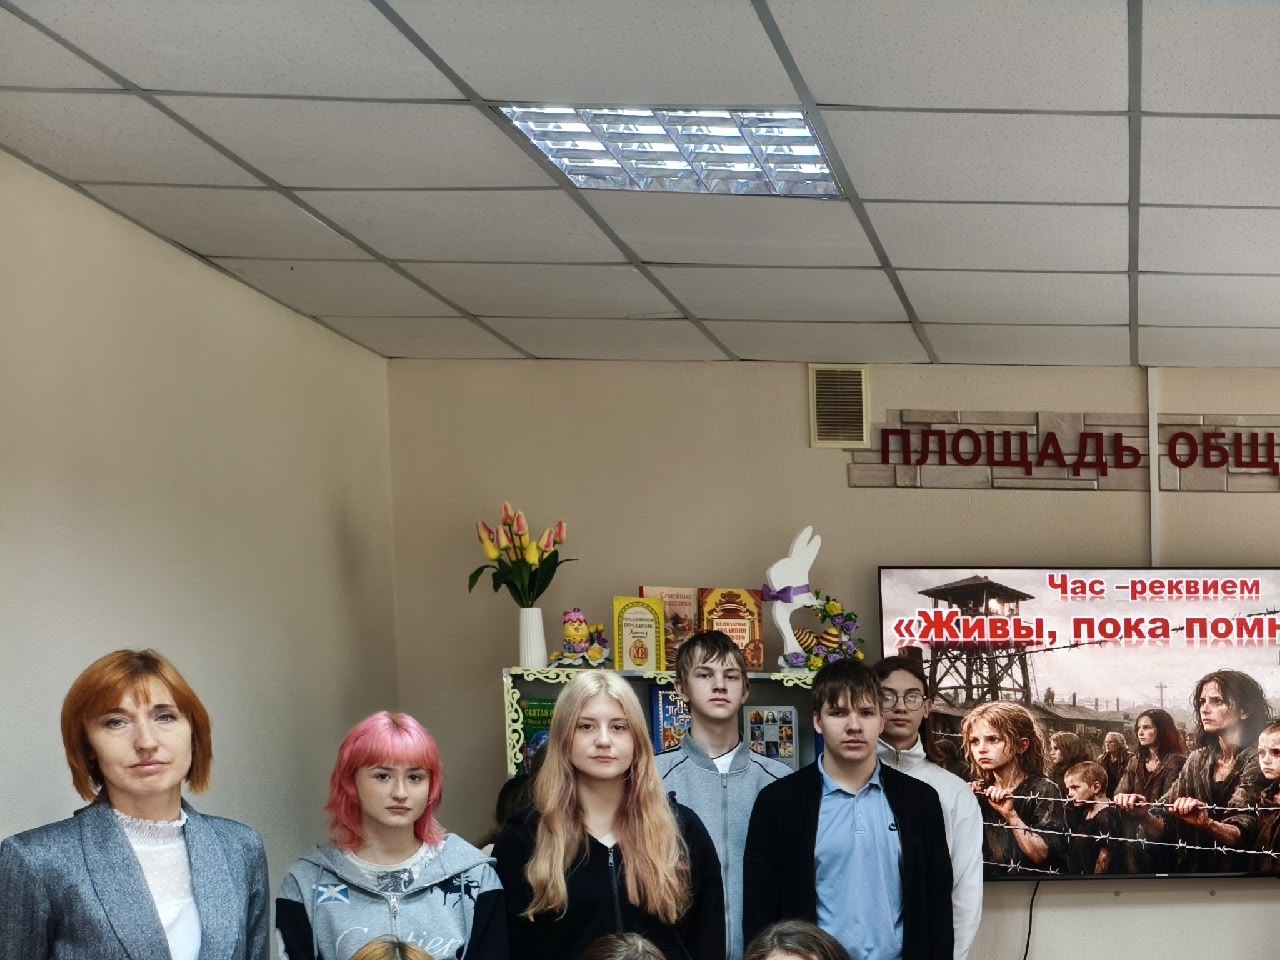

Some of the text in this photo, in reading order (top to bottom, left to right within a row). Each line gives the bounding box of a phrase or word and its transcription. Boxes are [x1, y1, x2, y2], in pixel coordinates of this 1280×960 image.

[881, 428, 1142, 476] ПЛОЩАДЬ
[1047, 573, 1106, 596] Час
[893, 609, 1057, 645] «Живы,
[1072, 616, 1170, 639] пока
